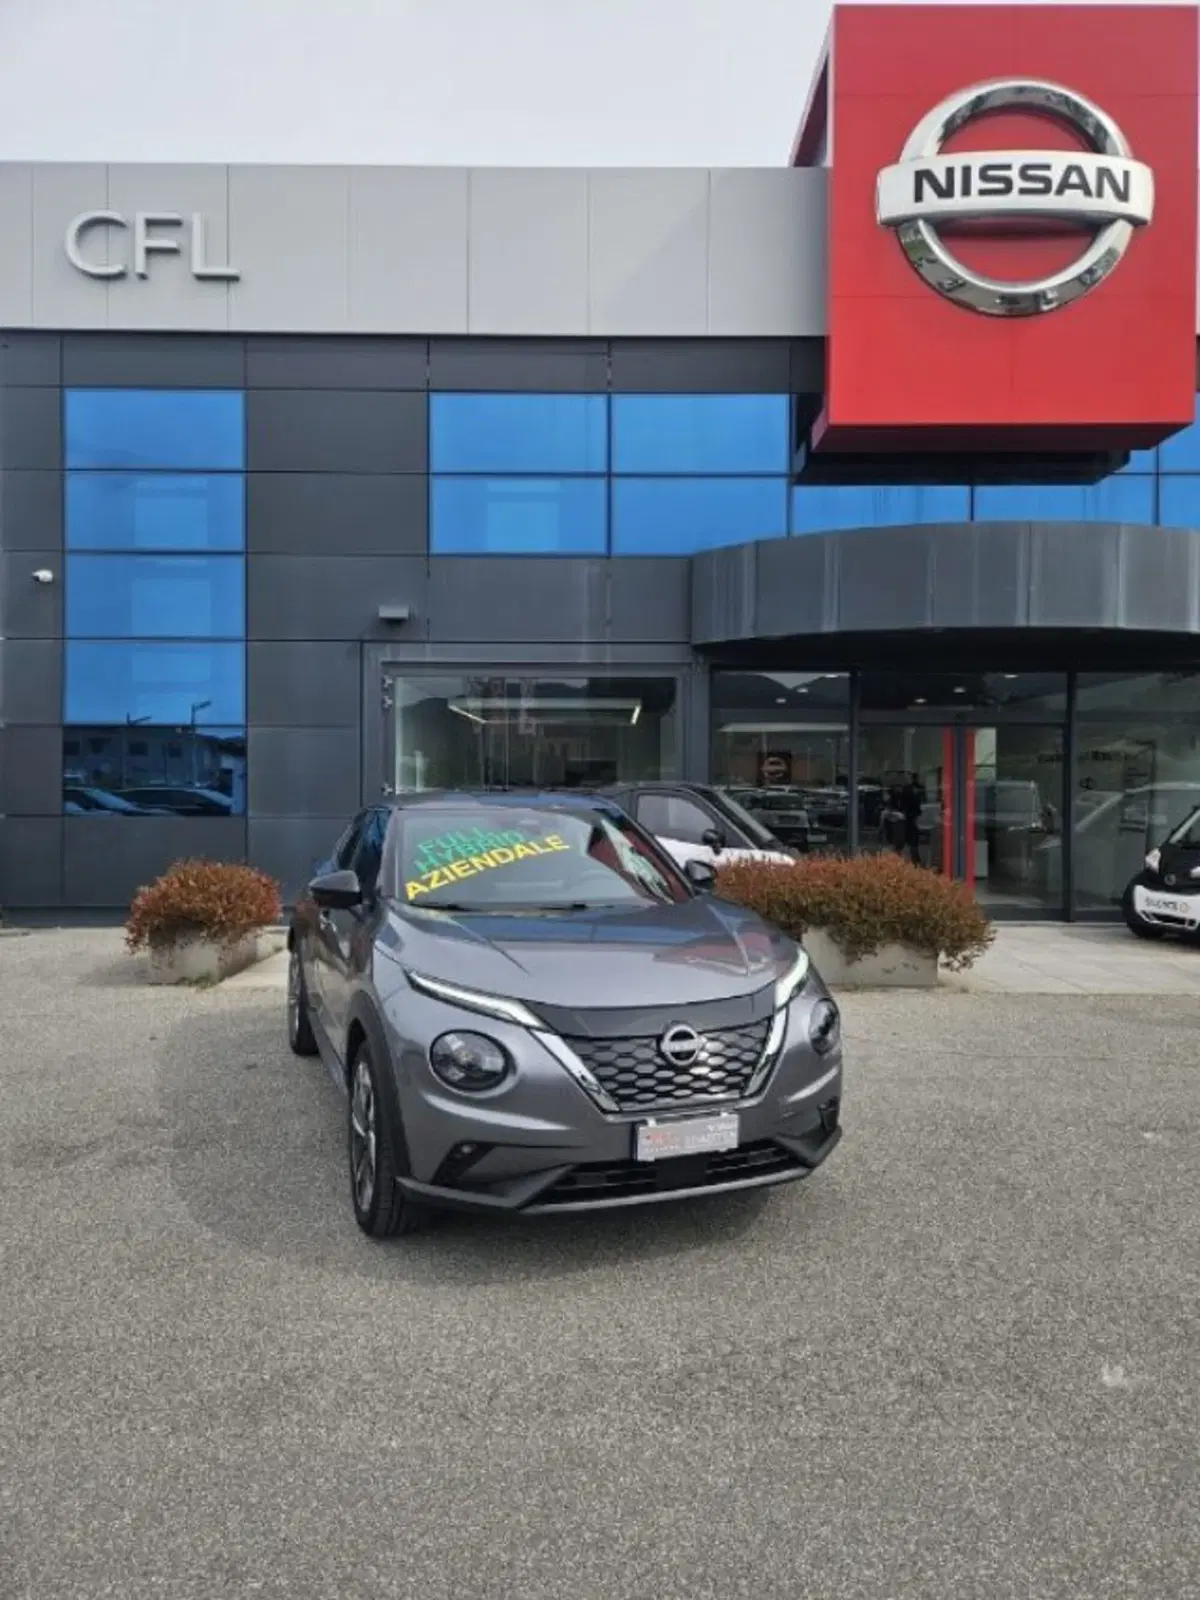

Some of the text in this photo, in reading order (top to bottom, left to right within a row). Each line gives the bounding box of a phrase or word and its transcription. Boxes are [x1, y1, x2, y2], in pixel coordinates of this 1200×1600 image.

[914, 163, 1131, 203] NISSAN
[65, 209, 240, 281] CFL
[405, 834, 570, 900] AZIENDALE
